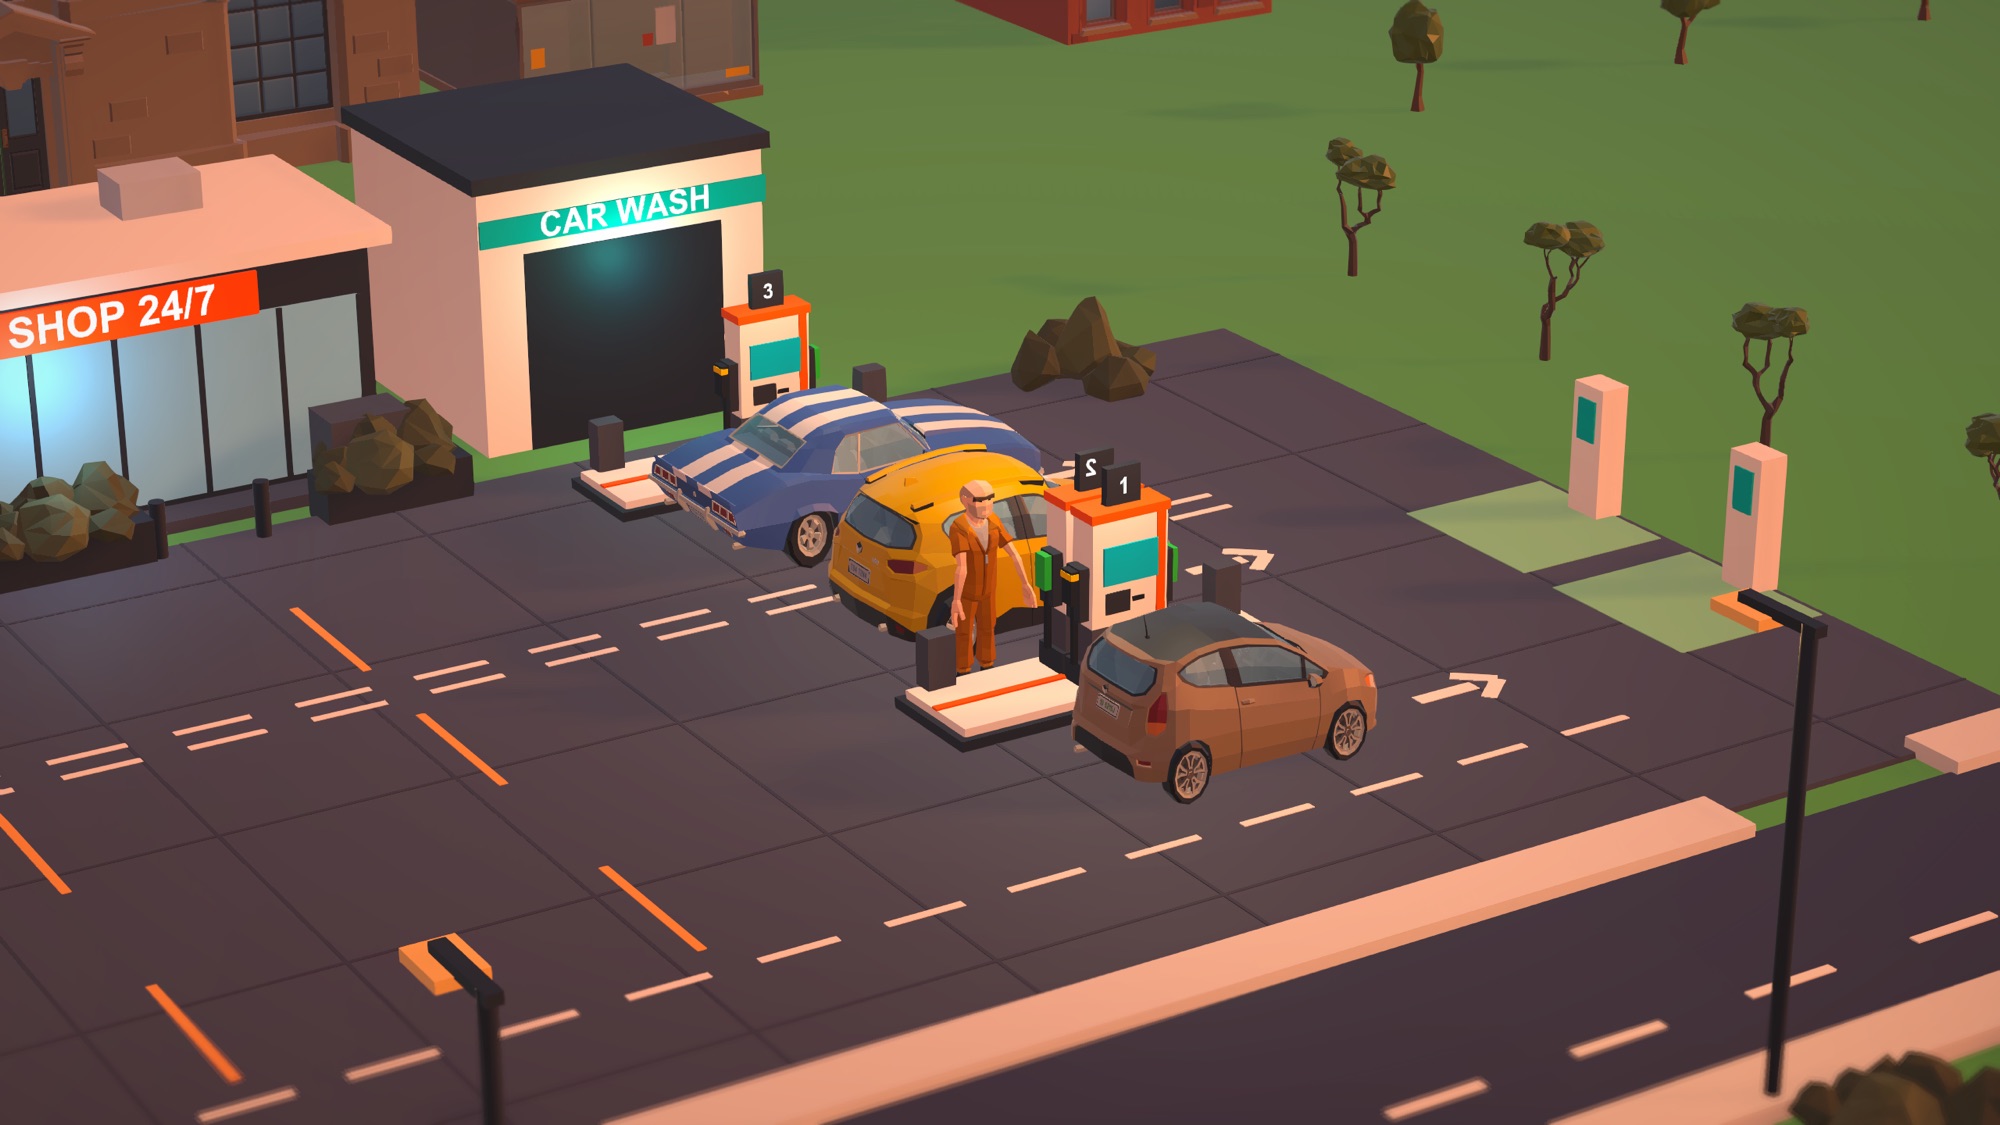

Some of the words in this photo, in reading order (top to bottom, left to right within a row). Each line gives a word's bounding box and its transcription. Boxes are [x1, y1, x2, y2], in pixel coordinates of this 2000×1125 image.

[540, 202, 608, 237] CAR
[616, 184, 710, 225] WASH
[763, 282, 774, 299] 3
[8, 300, 125, 349] SHOP
[138, 283, 215, 327] 24/7
[1120, 476, 1128, 495] 1
